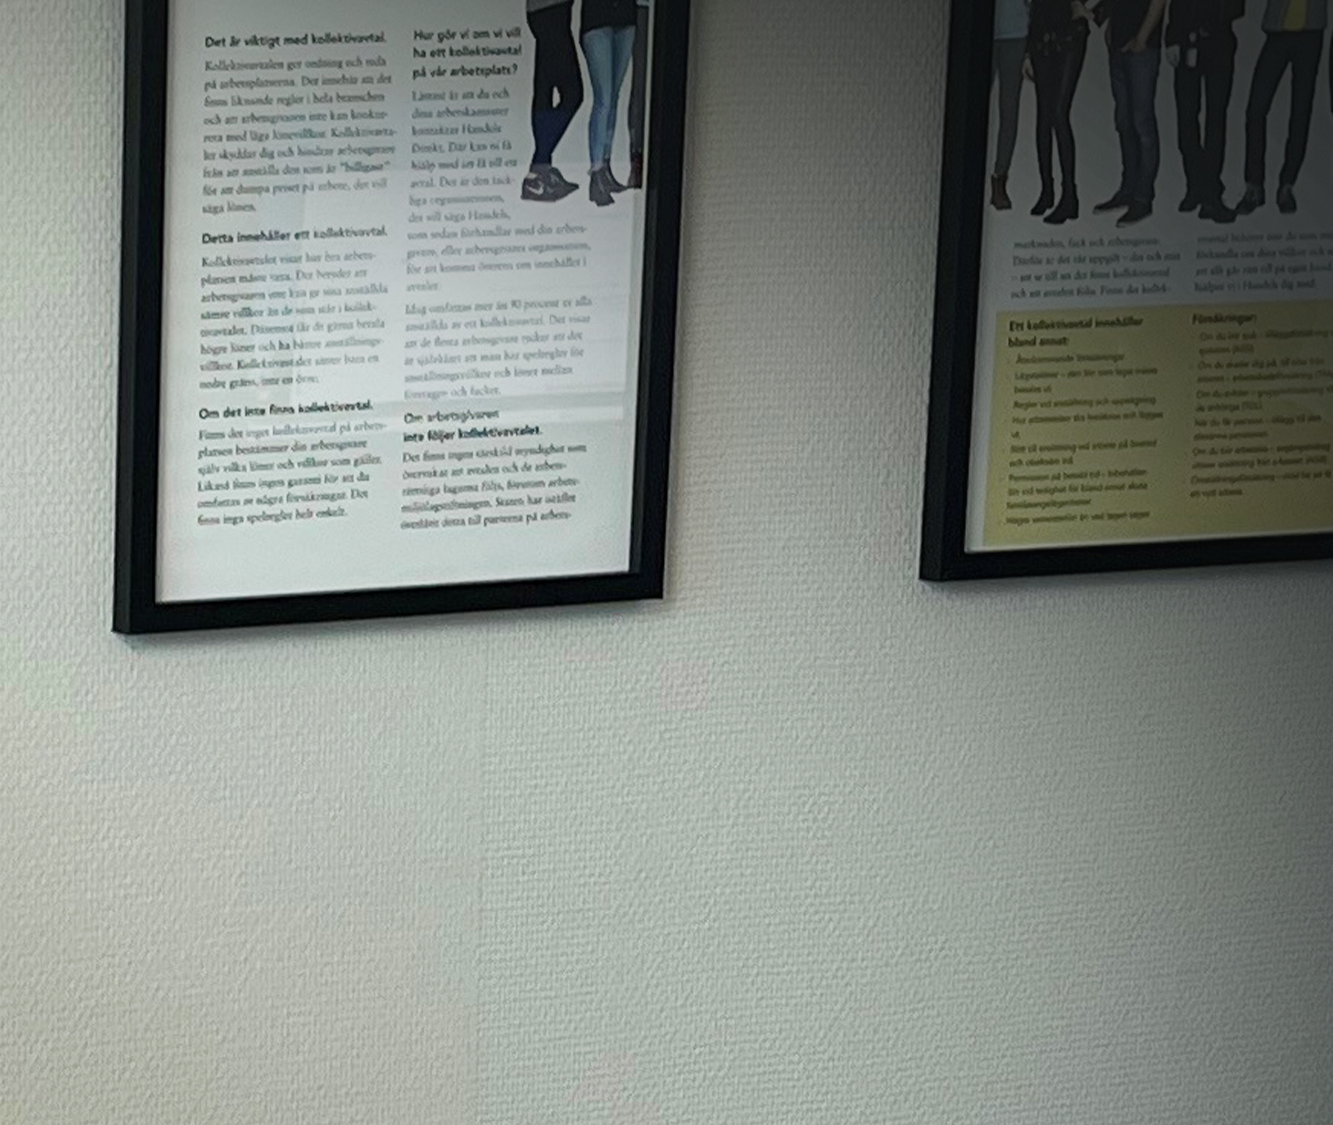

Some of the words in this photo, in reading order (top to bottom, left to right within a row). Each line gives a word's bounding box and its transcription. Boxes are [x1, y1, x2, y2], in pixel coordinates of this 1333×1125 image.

[205, 36, 225, 48] Det
[229, 35, 240, 46] är
[244, 34, 279, 49] viktigt
[283, 33, 308, 45] med
[311, 31, 386, 44] kollektivavtal.
[414, 30, 433, 40] Hur
[437, 29, 456, 43] gör
[459, 28, 469, 39] vi
[472, 30, 489, 39] om
[493, 29, 502, 37] vi
[505, 26, 520, 38] vill
[413, 46, 426, 58] ha
[429, 48, 445, 58] ett
[449, 44, 521, 56] kollektivavtal
[412, 66, 426, 80] på
[430, 65, 446, 77] vår
[450, 63, 517, 78] arbetsplats?
[202, 232, 233, 244] Detta
[237, 229, 290, 242] innehåller
[294, 230, 309, 240] ett
[313, 225, 388, 238] kollektivavtal.
[199, 407, 219, 419] Om
[223, 406, 241, 418] det
[245, 405, 265, 416] inte
[269, 403, 294, 414] finns
[298, 399, 373, 413] kollektivavtal.
